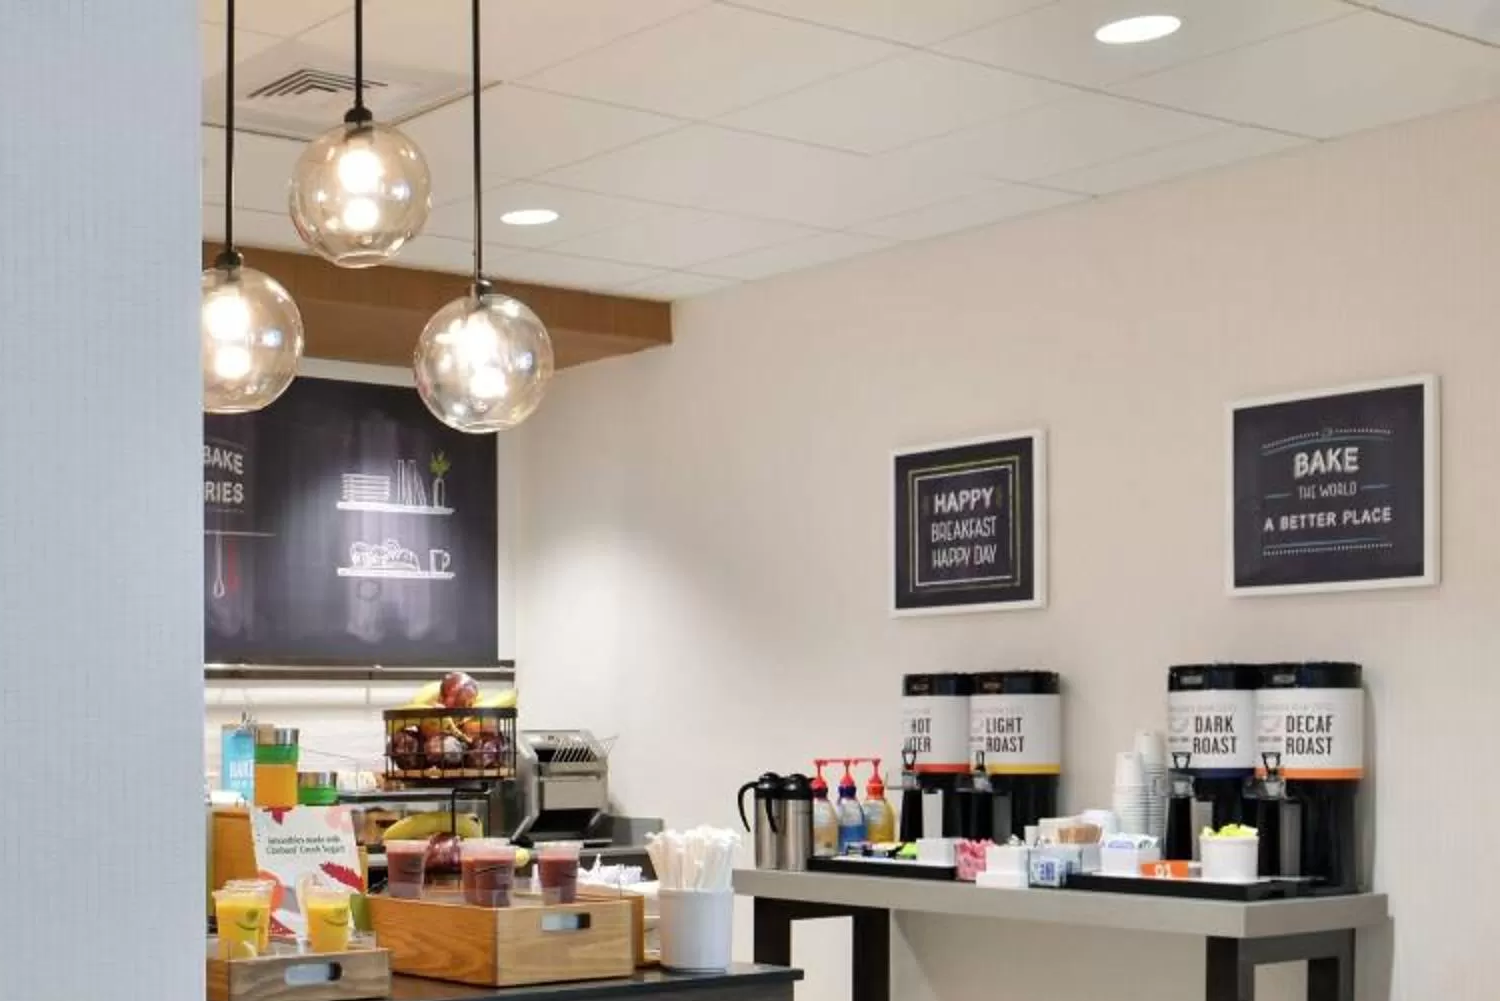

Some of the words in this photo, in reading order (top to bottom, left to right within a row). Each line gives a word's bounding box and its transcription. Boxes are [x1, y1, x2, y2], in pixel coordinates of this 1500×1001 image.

[204, 445, 244, 475] BAKE
[1294, 447, 1359, 479] BAKE
[204, 481, 244, 504] RIES
[933, 486, 994, 514] HAPPY
[1298, 483, 1316, 500] THE
[1320, 481, 1357, 498] WORLD
[931, 515, 997, 542] BREAKFAST
[1263, 517, 1274, 532] A
[1279, 512, 1336, 531] BETTER
[1342, 507, 1392, 525] PLACE
[932, 545, 970, 569] HAPPY
[974, 543, 997, 566] DAY
[985, 717, 1023, 734] LIGHT
[1195, 715, 1235, 733] DARK
[1285, 715, 1334, 733] DECAF
[985, 736, 1025, 753] ROAST
[1192, 736, 1237, 755] ROAST
[1285, 736, 1334, 755] ROAST
